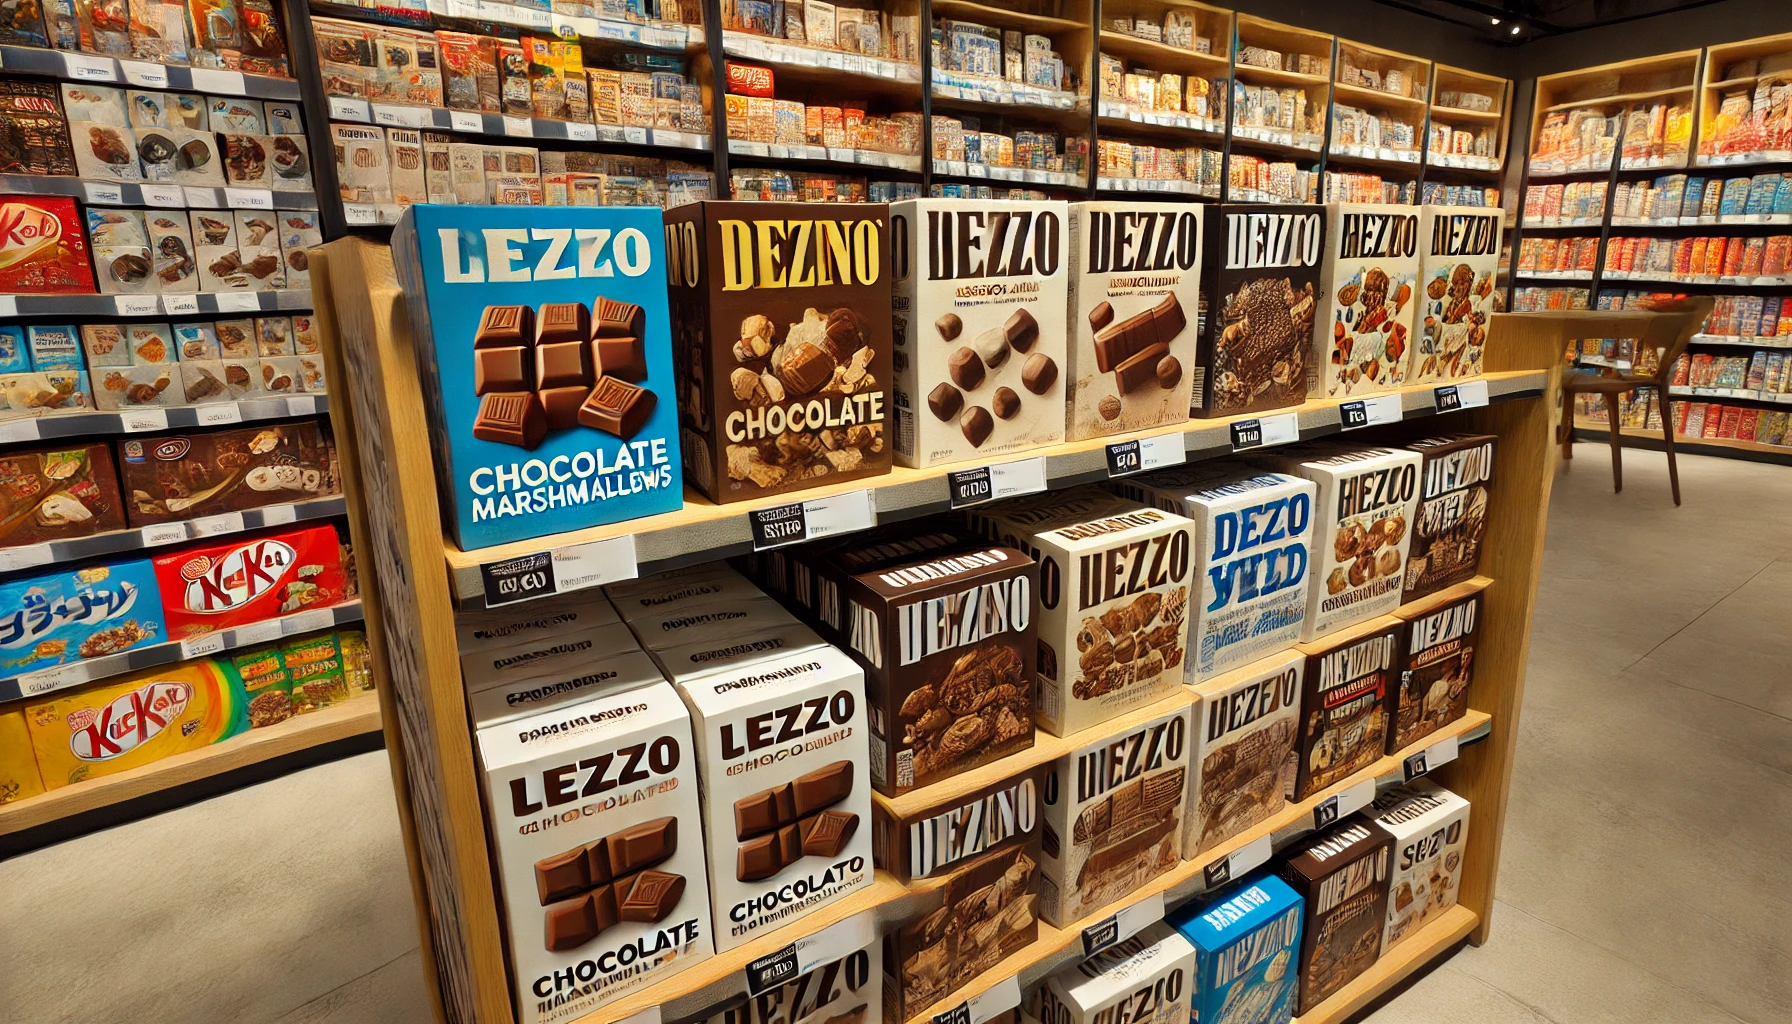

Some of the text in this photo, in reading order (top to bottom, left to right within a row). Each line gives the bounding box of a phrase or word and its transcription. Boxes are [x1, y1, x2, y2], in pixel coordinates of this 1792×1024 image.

[438, 227, 652, 283] LEZZO
[725, 391, 884, 442] CHOCOLATE
[469, 438, 668, 495] CHOCOLATE
[1211, 493, 1310, 562] DEZO
[720, 690, 855, 761] LEZZO
[509, 735, 680, 817] LEZZO
[729, 856, 865, 923] CHOCOLATO
[532, 918, 699, 998] CHOCOLATE
